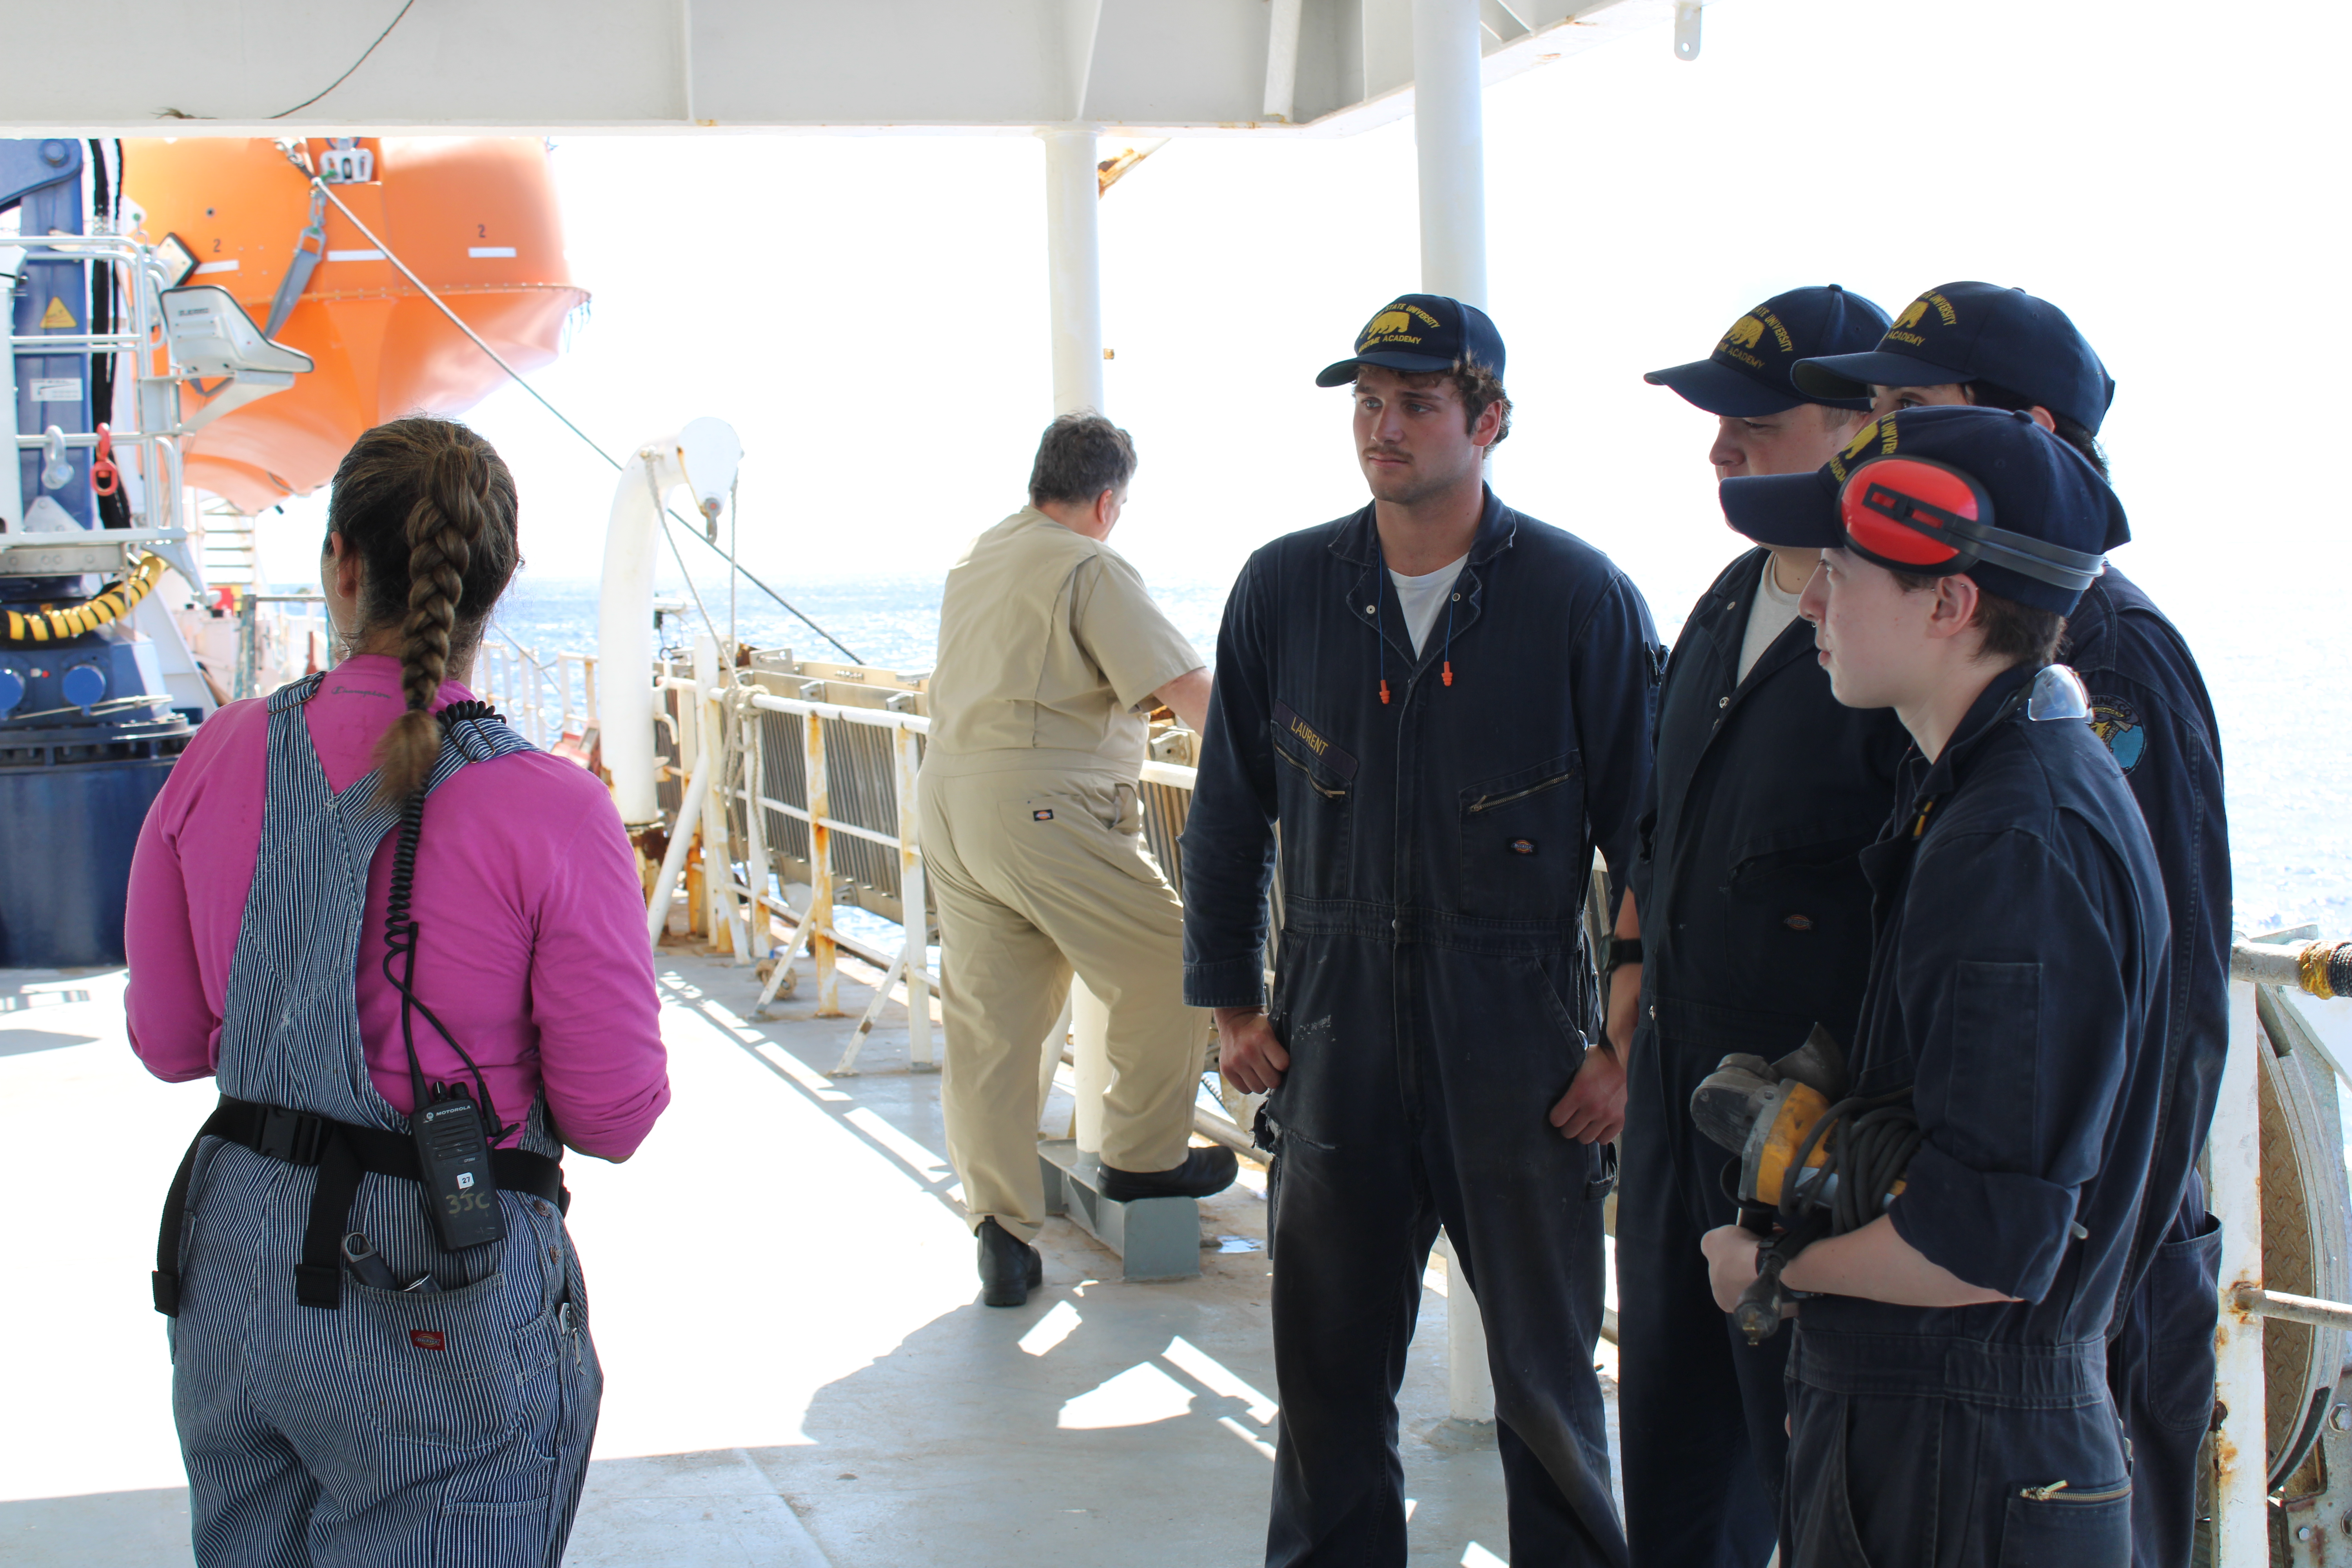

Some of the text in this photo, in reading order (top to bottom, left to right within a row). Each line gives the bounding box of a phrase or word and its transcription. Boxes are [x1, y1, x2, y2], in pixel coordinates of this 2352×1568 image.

[478, 224, 485, 237] 2
[213, 238, 221, 252] 2
[1385, 303, 1441, 328] STATE UNIVERSITY
[1929, 294, 1957, 326] UNIVERSITY
[1382, 335, 1422, 344] ACADEMY
[1764, 314, 1793, 352] UNIVERSITY
[1886, 330, 1926, 347] ACADEMY
[1727, 347, 1766, 370] ACADEMY
[1881, 421, 1898, 455] UNIVERS
[1829, 456, 1847, 485] ACADEM
[331, 686, 391, 699] Champion
[1291, 717, 1328, 756] LAURENT
[436, 1105, 471, 1116] MOTOROLA
